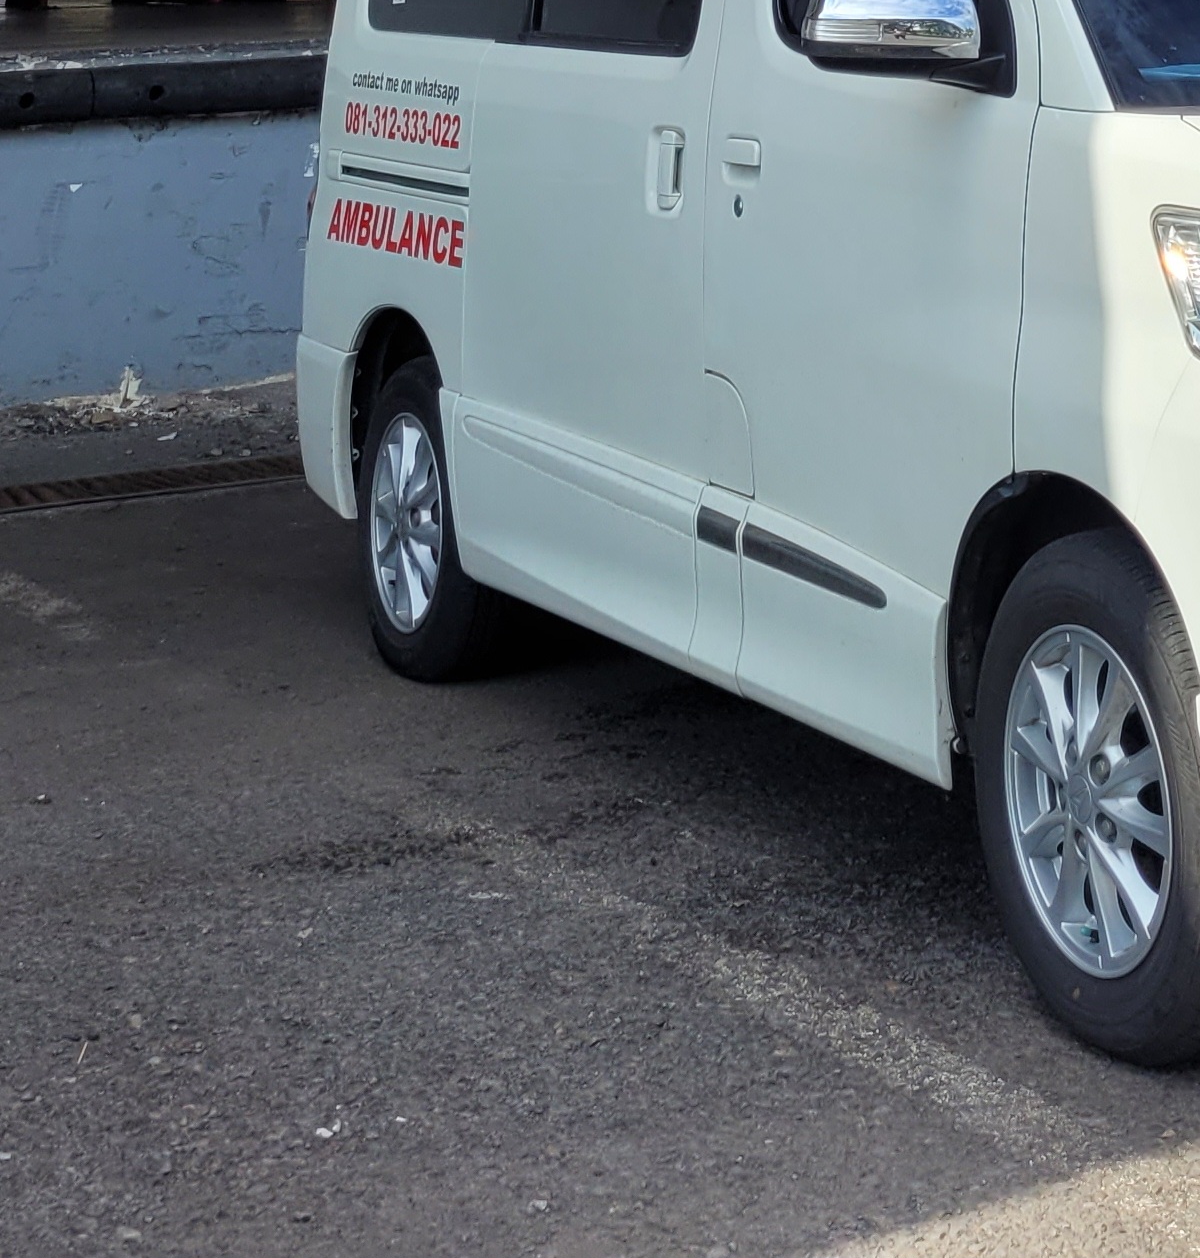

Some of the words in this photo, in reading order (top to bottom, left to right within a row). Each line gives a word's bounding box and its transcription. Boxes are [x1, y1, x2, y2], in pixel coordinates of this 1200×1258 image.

[352, 71, 384, 91] contact
[385, 77, 398, 92] me
[401, 79, 412, 94] on
[414, 77, 460, 105] whatsapp
[345, 101, 462, 150] 081-312-333-022
[327, 198, 465, 269] AMBULANCE
